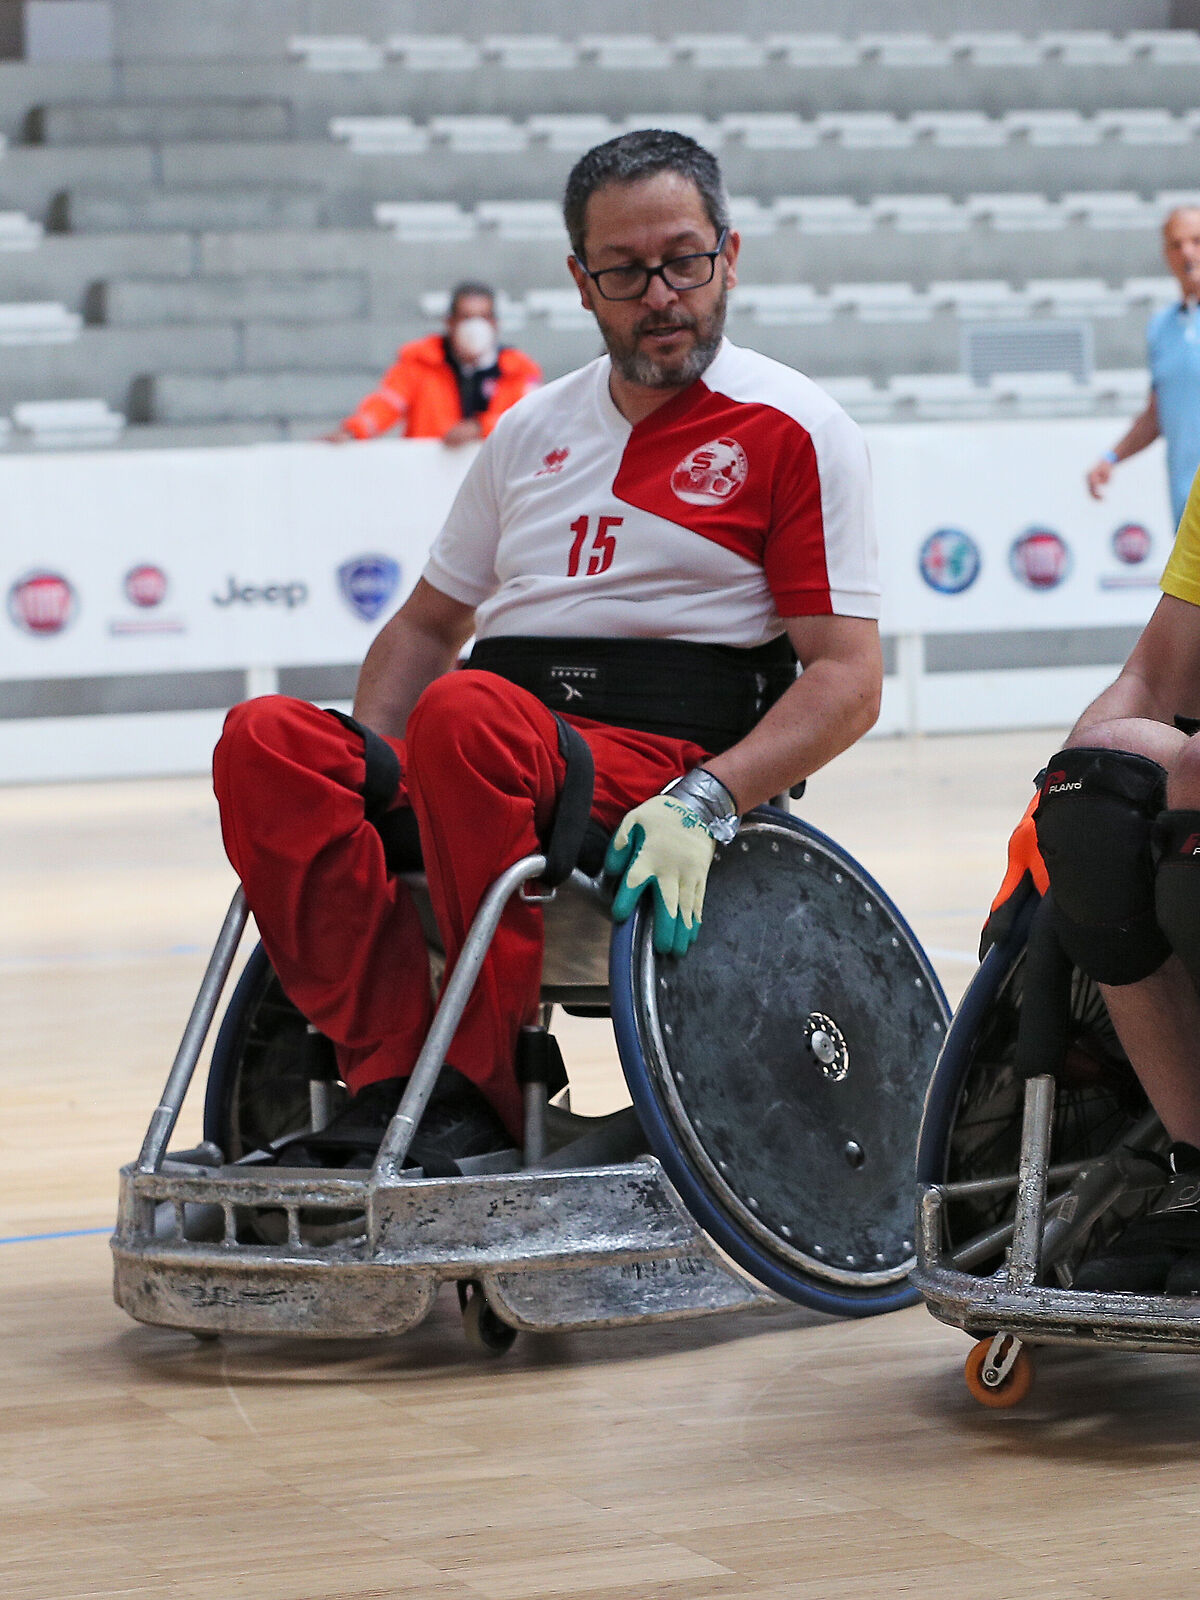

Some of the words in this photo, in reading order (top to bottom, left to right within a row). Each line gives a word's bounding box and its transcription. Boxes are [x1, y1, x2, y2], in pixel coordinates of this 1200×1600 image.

[567, 514, 624, 577] 15
[213, 575, 309, 608] Jeep
[1048, 782, 1082, 794] PLANO
